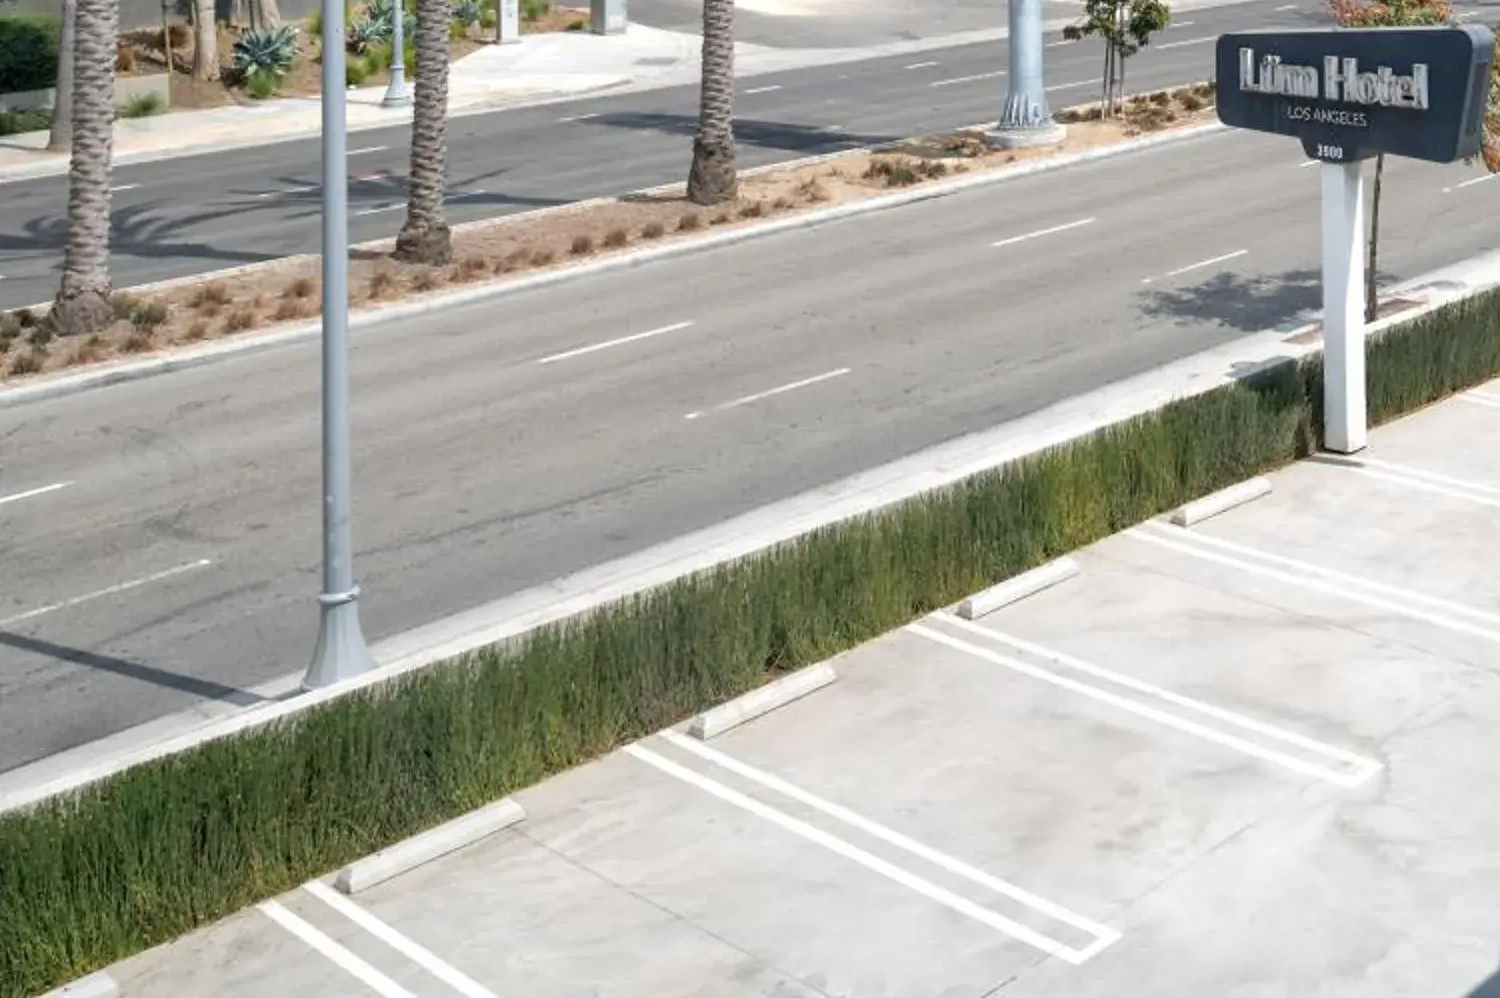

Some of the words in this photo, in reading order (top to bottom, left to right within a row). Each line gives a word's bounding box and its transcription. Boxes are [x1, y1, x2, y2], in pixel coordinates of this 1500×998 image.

[1324, 55, 1429, 110] Hotel
[1287, 105, 1312, 121] LOS
[1313, 107, 1368, 127] ANGELES
